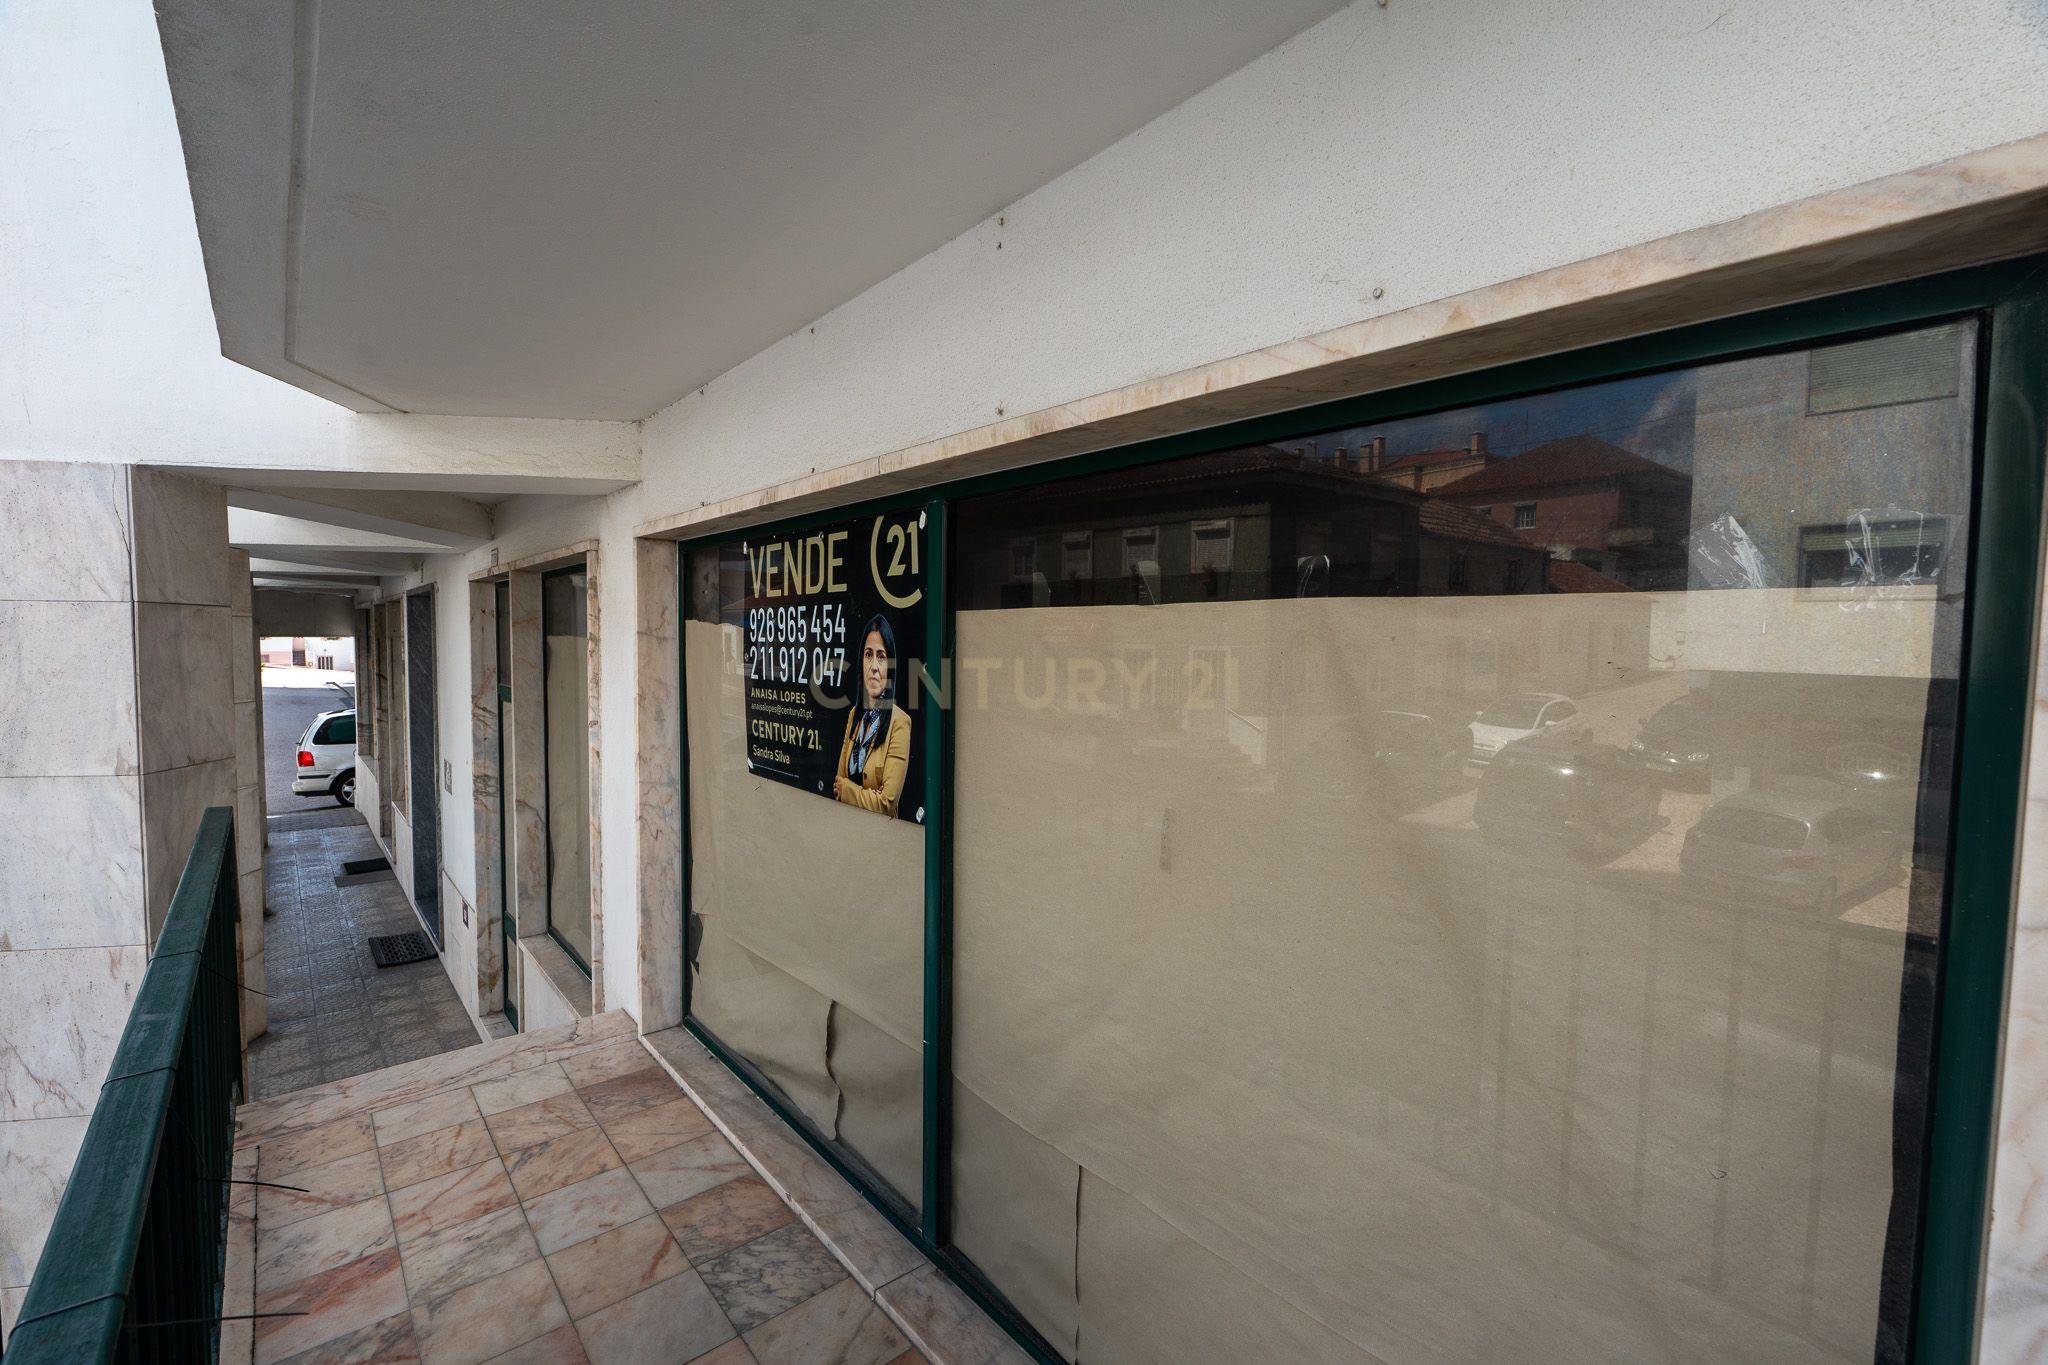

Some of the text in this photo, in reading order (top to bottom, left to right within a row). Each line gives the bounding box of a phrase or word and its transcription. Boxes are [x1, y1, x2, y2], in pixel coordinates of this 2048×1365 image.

[750, 531, 848, 598] VENDE
[750, 603, 845, 643] 926 965 454
[750, 645, 845, 686] 211 912 047
[751, 687, 806, 704] ANAISA LOPES
[752, 719, 805, 747] CENTURY
[753, 744, 790, 764] Sandra Silva
